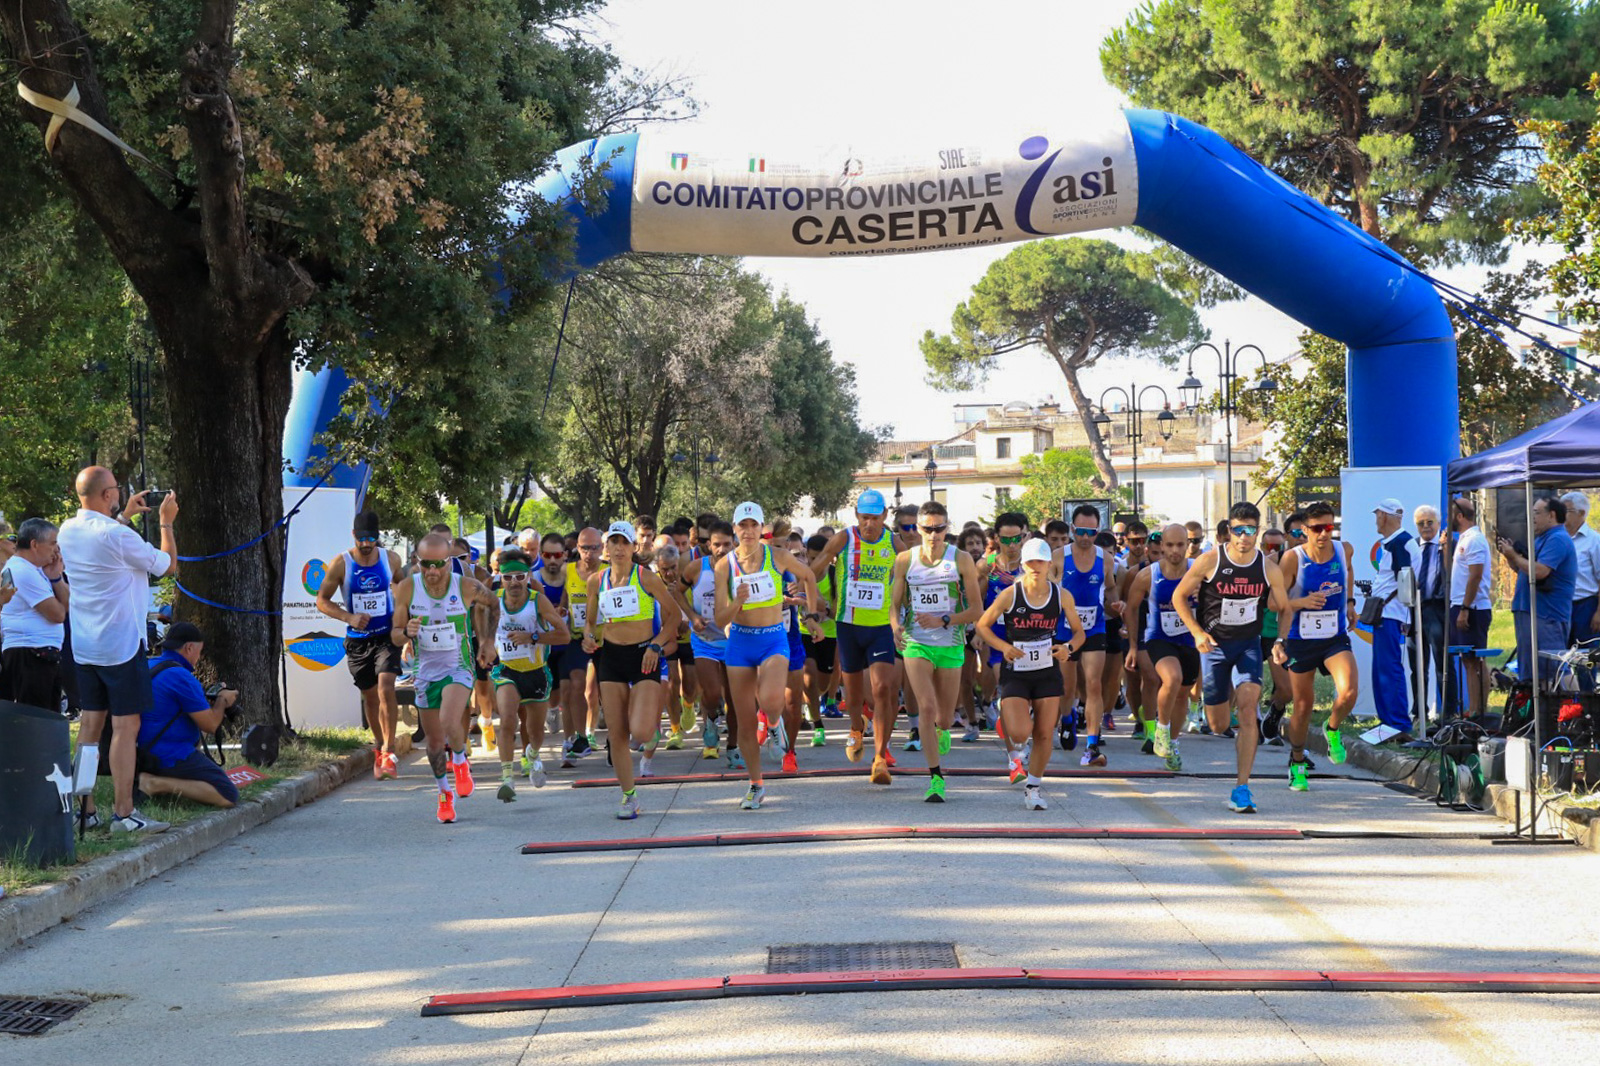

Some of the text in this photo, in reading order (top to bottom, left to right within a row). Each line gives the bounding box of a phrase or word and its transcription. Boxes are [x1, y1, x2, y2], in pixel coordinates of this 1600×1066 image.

[938, 148, 967, 170] SIAE
[1053, 156, 1117, 204] asi
[792, 202, 1004, 246] CASERTA
[829, 236, 1003, 256] caserta@asinazionale.it
[751, 583, 759, 594] 11
[858, 590, 873, 600] 173
[920, 593, 938, 604] 260
[363, 601, 377, 610] 122
[613, 597, 623, 608] 12
[1239, 608, 1245, 617] 9
[738, 627, 761, 635] NIKE
[762, 624, 782, 634] PRO
[432, 633, 439, 643] 6
[503, 642, 518, 652] 169
[1029, 650, 1039, 661] 13
